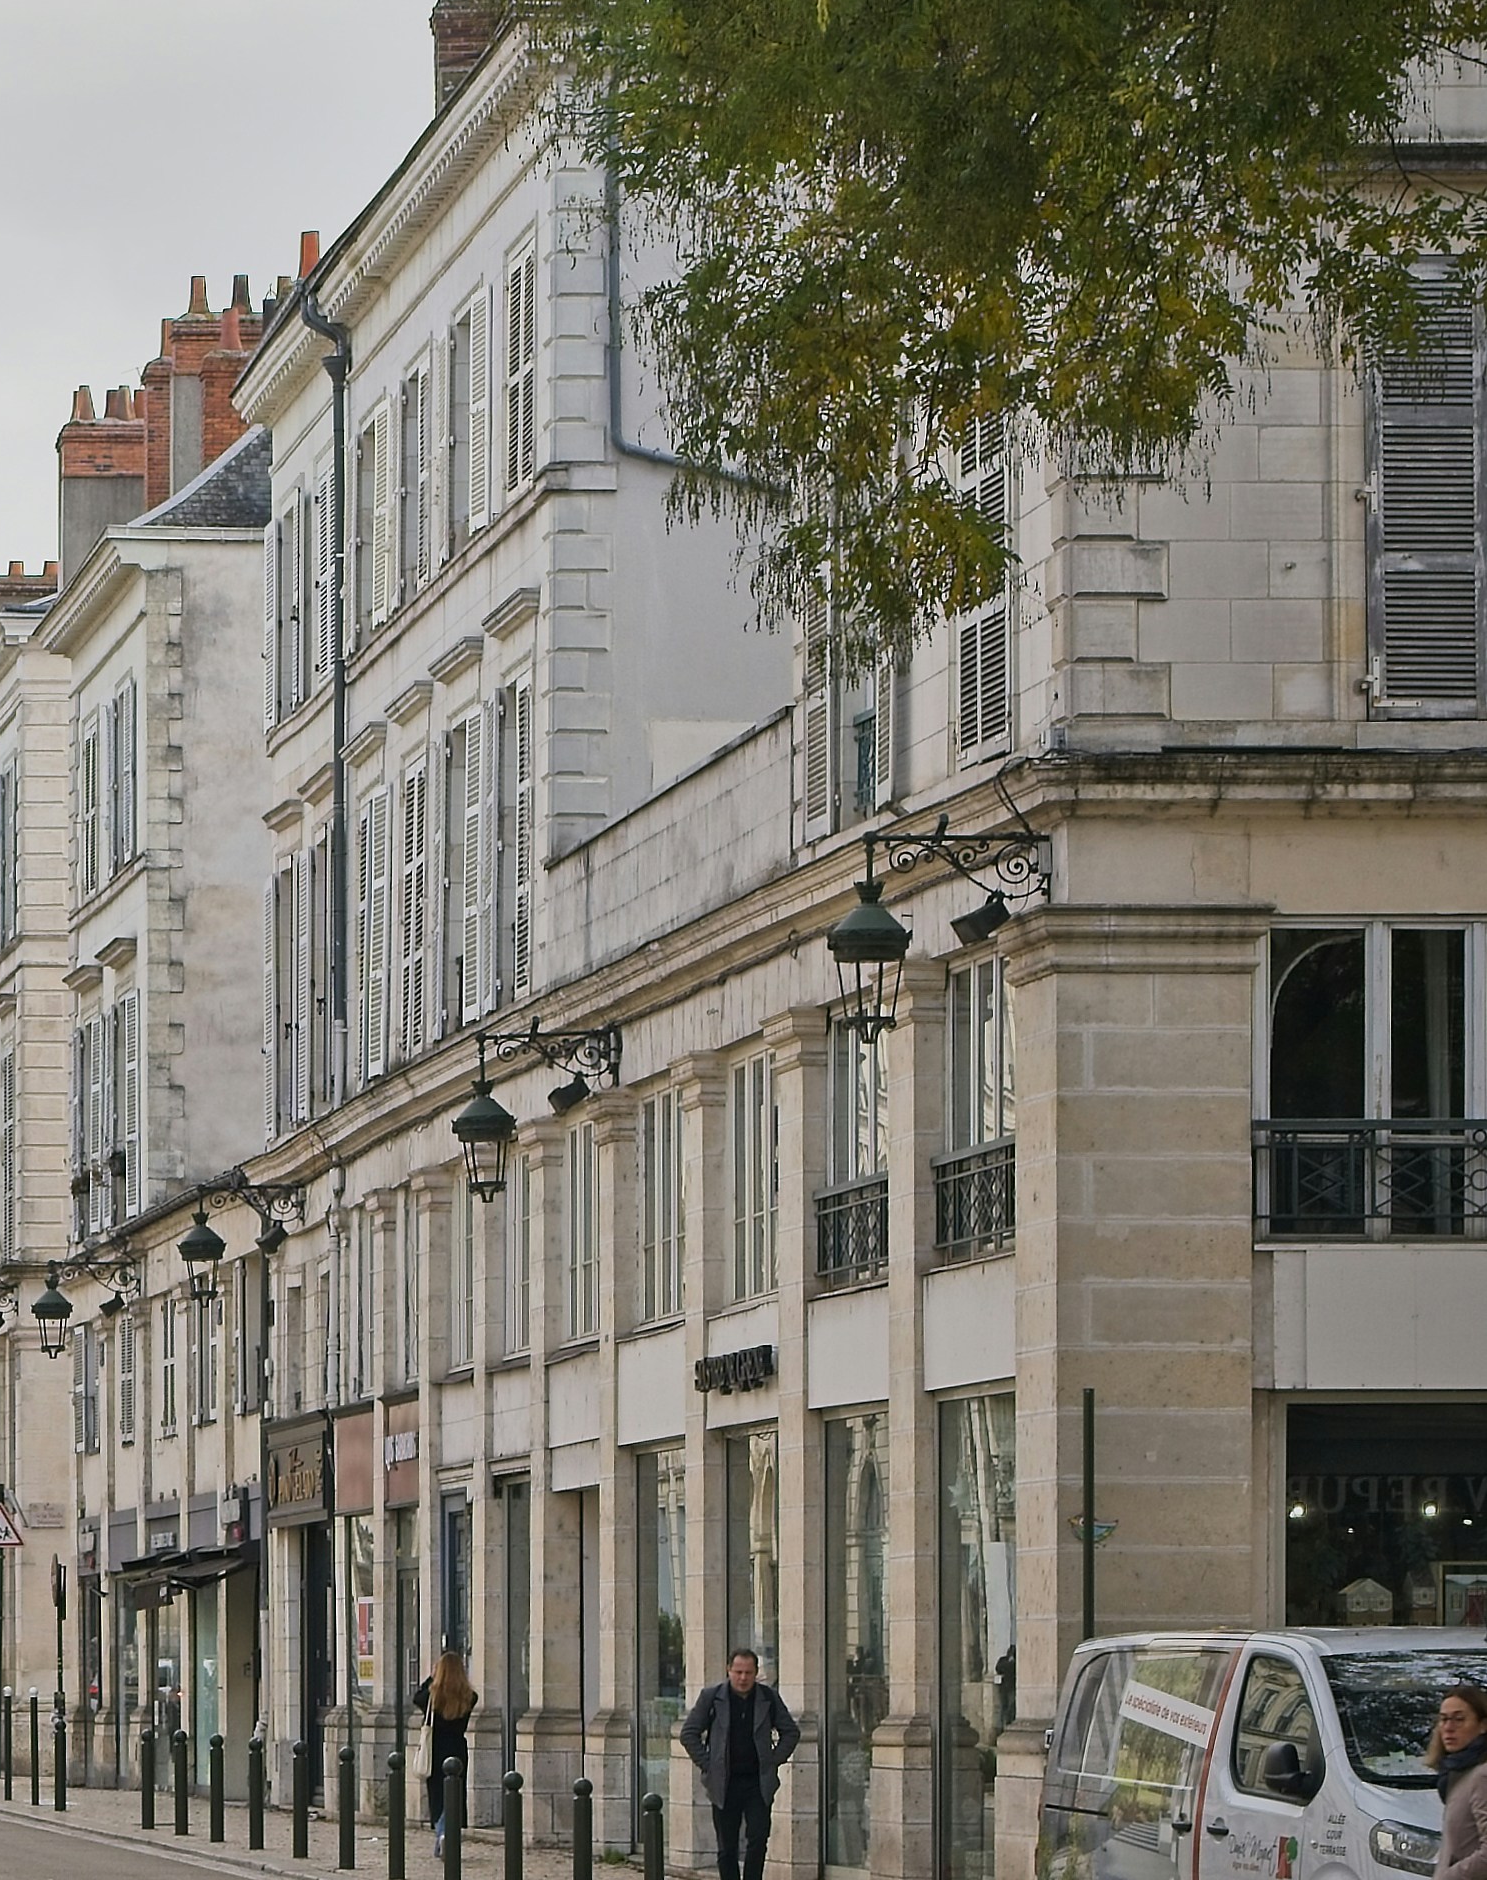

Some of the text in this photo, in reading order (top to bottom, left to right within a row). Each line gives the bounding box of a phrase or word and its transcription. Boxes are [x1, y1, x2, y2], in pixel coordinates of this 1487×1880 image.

[1132, 1694, 1161, 1717] spécialiste
[1161, 1705, 1170, 1720] de
[1328, 1813, 1346, 1825] ALLÉE
[1326, 1829, 1343, 1840] COUR
[1319, 1844, 1347, 1856] TERRASSE
